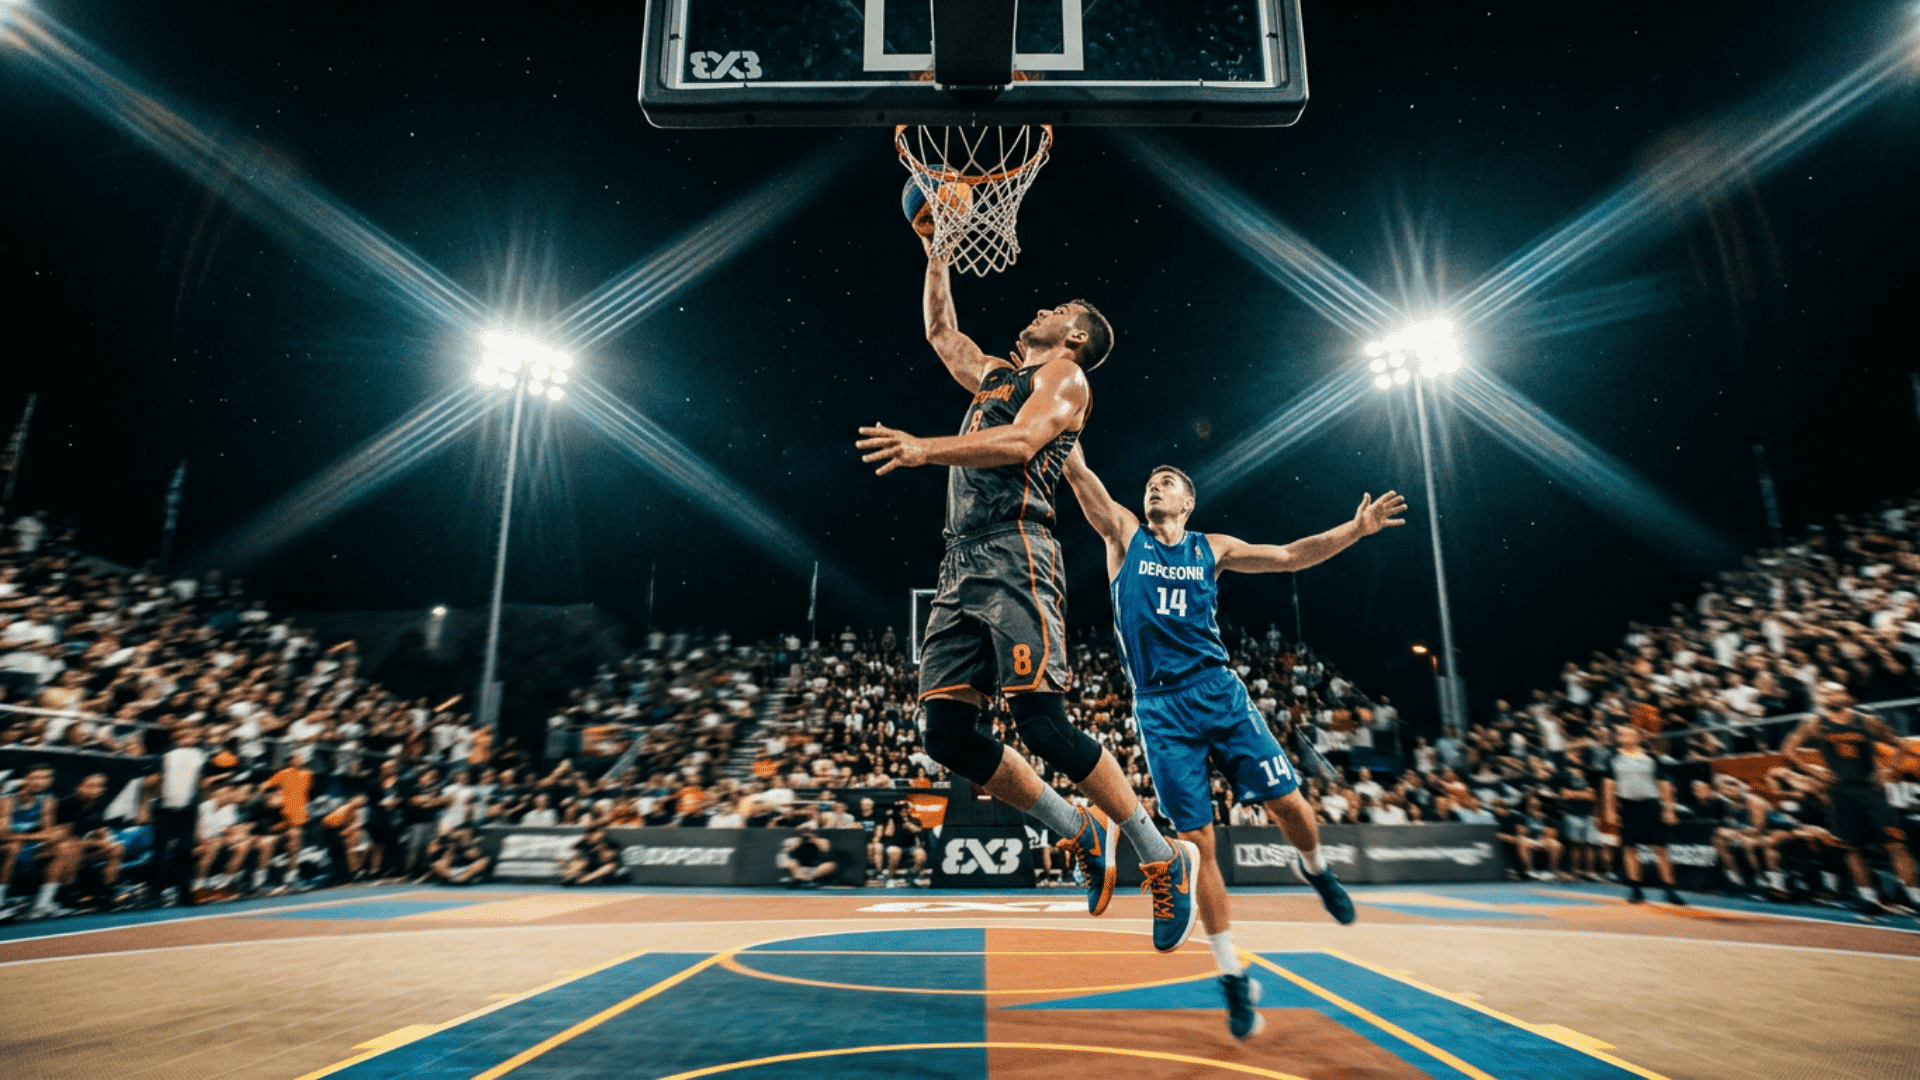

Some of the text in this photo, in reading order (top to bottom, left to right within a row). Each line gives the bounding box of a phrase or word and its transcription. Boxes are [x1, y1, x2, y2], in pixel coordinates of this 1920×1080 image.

[1156, 587, 1187, 617] 14
[1013, 643, 1032, 676] 8
[1259, 754, 1292, 787] 14
